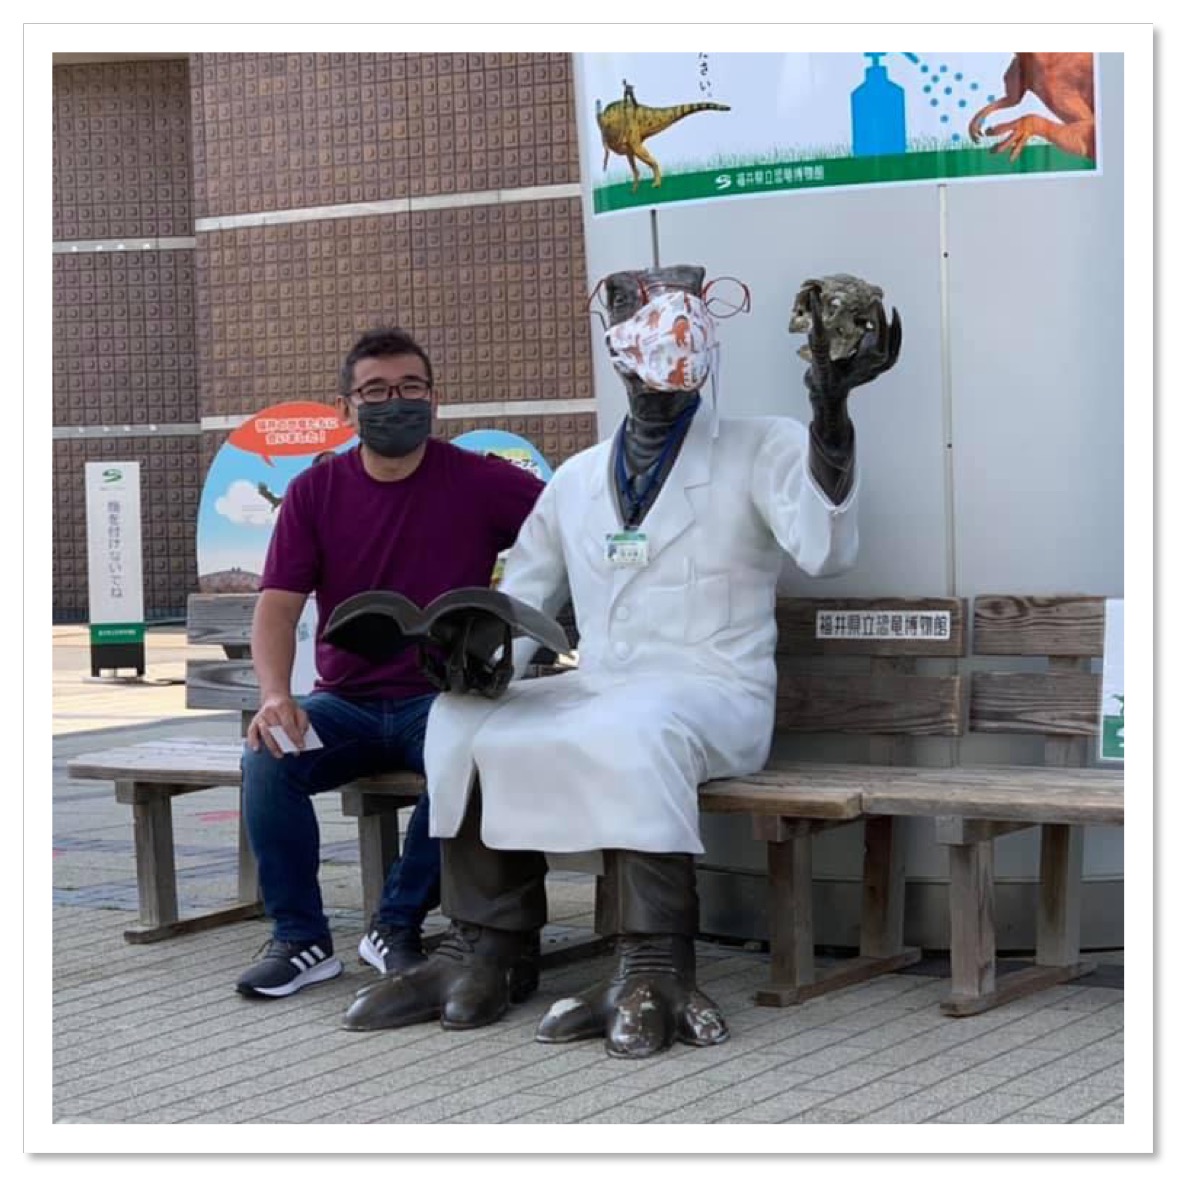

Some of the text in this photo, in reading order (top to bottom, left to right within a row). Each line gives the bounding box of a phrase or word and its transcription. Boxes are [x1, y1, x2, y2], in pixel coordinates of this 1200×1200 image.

[820, 614, 947, 636] 福井県立恐竜博物館
